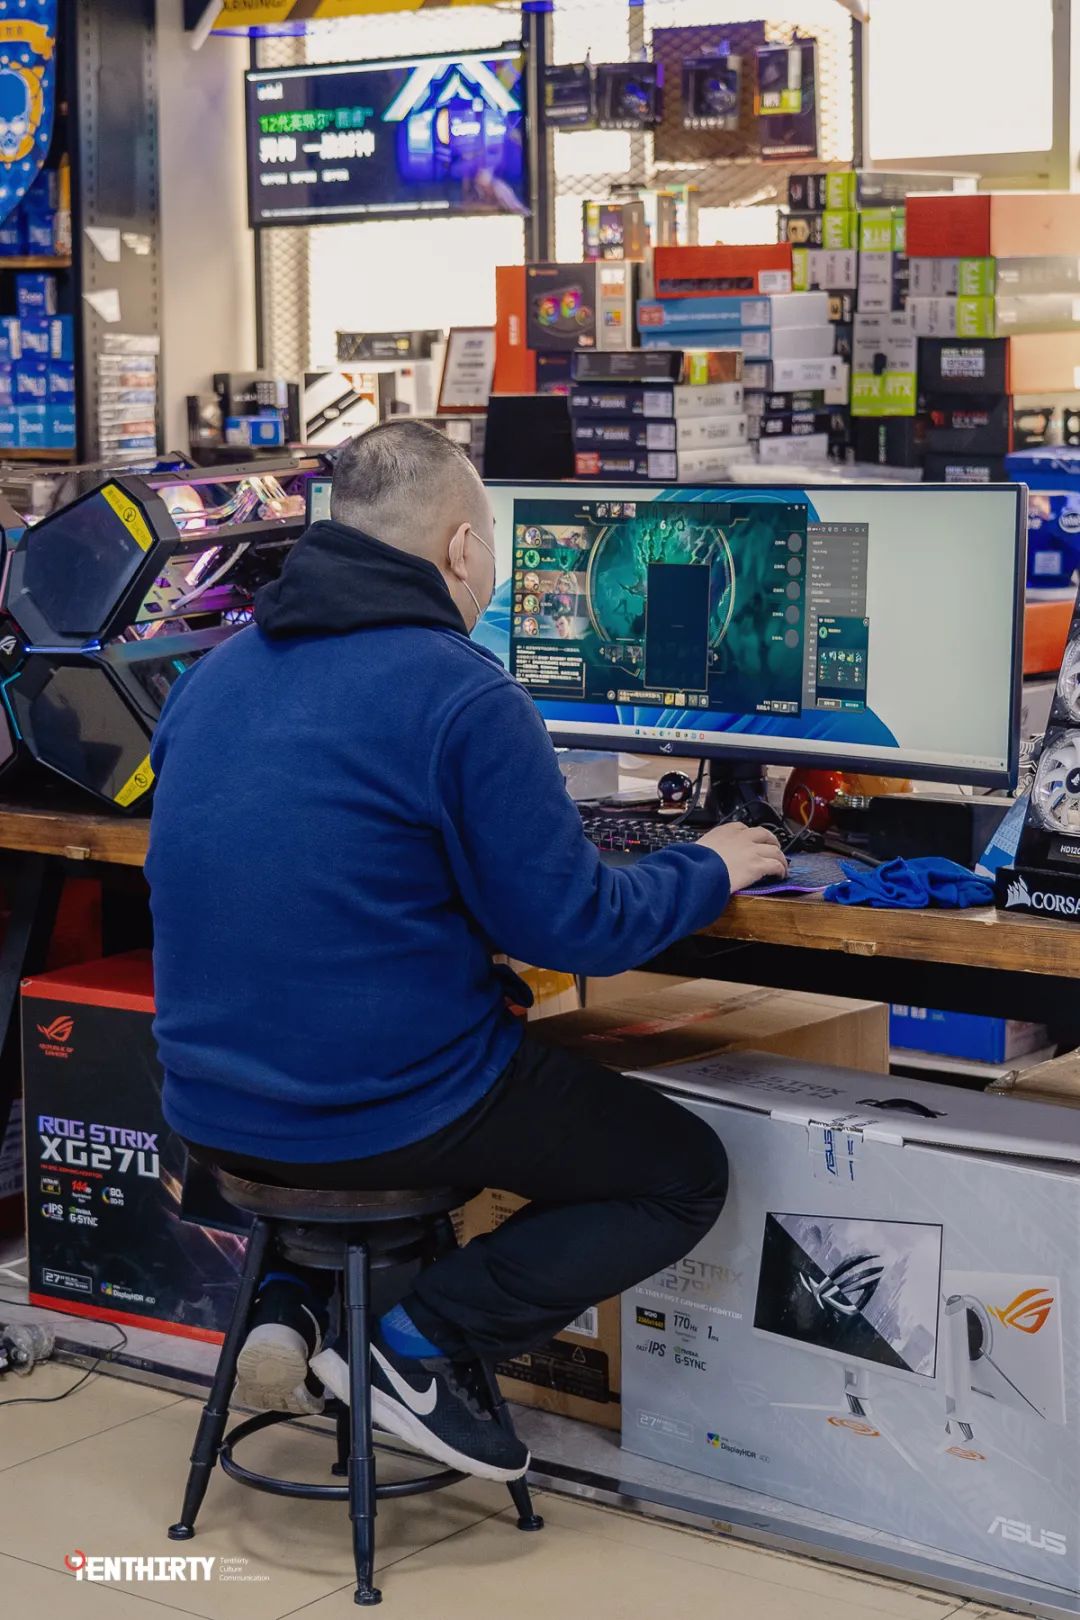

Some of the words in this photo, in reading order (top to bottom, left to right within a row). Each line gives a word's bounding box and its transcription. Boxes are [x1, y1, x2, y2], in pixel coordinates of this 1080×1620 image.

[38, 1115, 85, 1140] ROG
[89, 1123, 159, 1153] STRIX
[40, 1135, 160, 1178] XG27U
[48, 1203, 64, 1215] IPS
[69, 1213, 99, 1227] G-SYNC
[648, 1340, 666, 1357] IPS
[674, 1353, 707, 1371] G-SYNC
[720, 1441, 757, 1460] DisplayHDR
[986, 1516, 1067, 1556] ASUS
